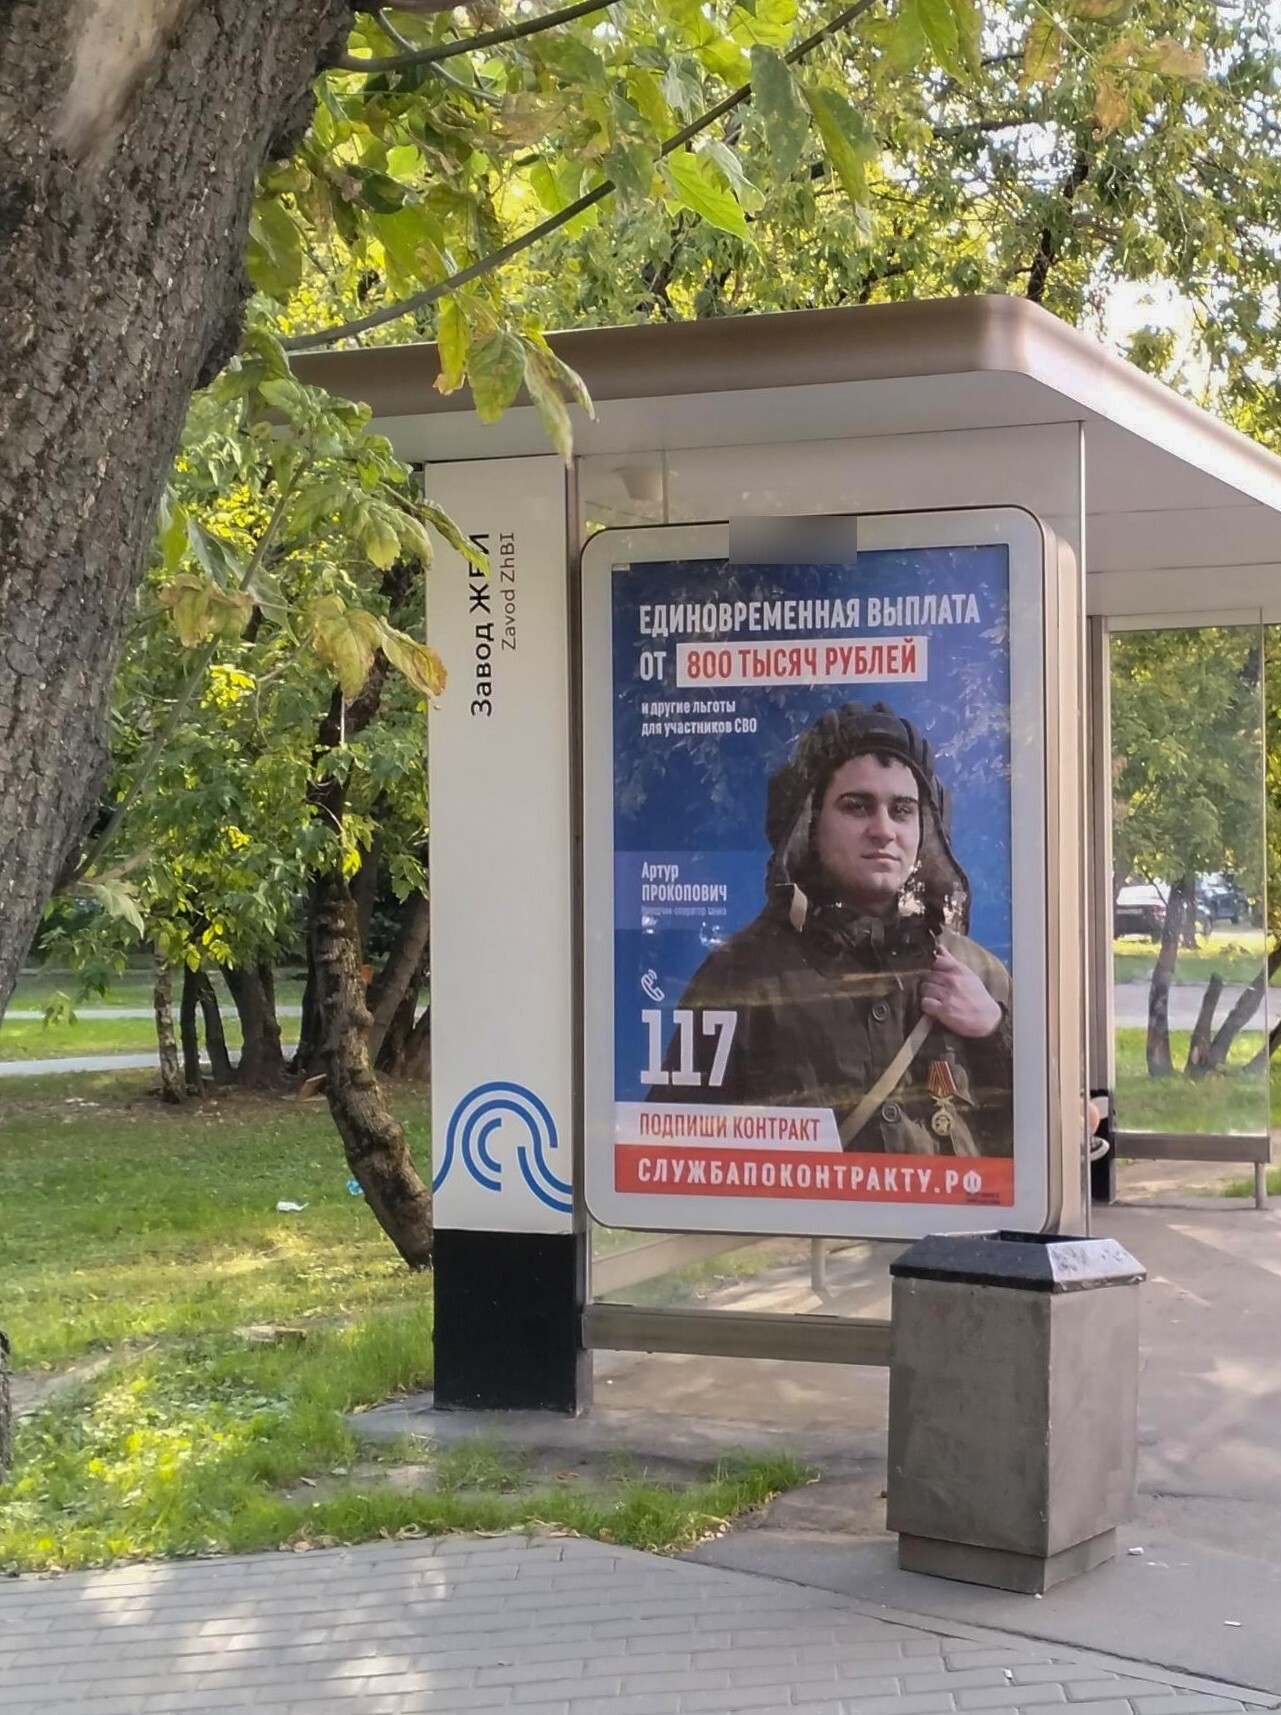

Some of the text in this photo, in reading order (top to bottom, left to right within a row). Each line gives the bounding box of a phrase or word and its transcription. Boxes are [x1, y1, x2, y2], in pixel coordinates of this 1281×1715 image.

[500, 532, 517, 652] Zavod ZhBI
[639, 593, 981, 638] ЕДИНОВРЕМЕННАЯ ВЫПЛАТА
[470, 622, 495, 717] Завод
[639, 637, 917, 681] ОТ 800 ТЫСЯЧ РУБЛЕЙ
[641, 700, 736, 717] и другие льготы
[641, 717, 757, 738] для участников СВО
[641, 861, 679, 882] Артур
[641, 884, 727, 902] ПРОКОПОВИЧ
[640, 1009, 738, 1087] 117
[639, 1113, 821, 1142] ПОДПИШИ КОНТРАКТ
[638, 1157, 982, 1195] СЛУЖБАПОКОНТРАКТУ.РФ
